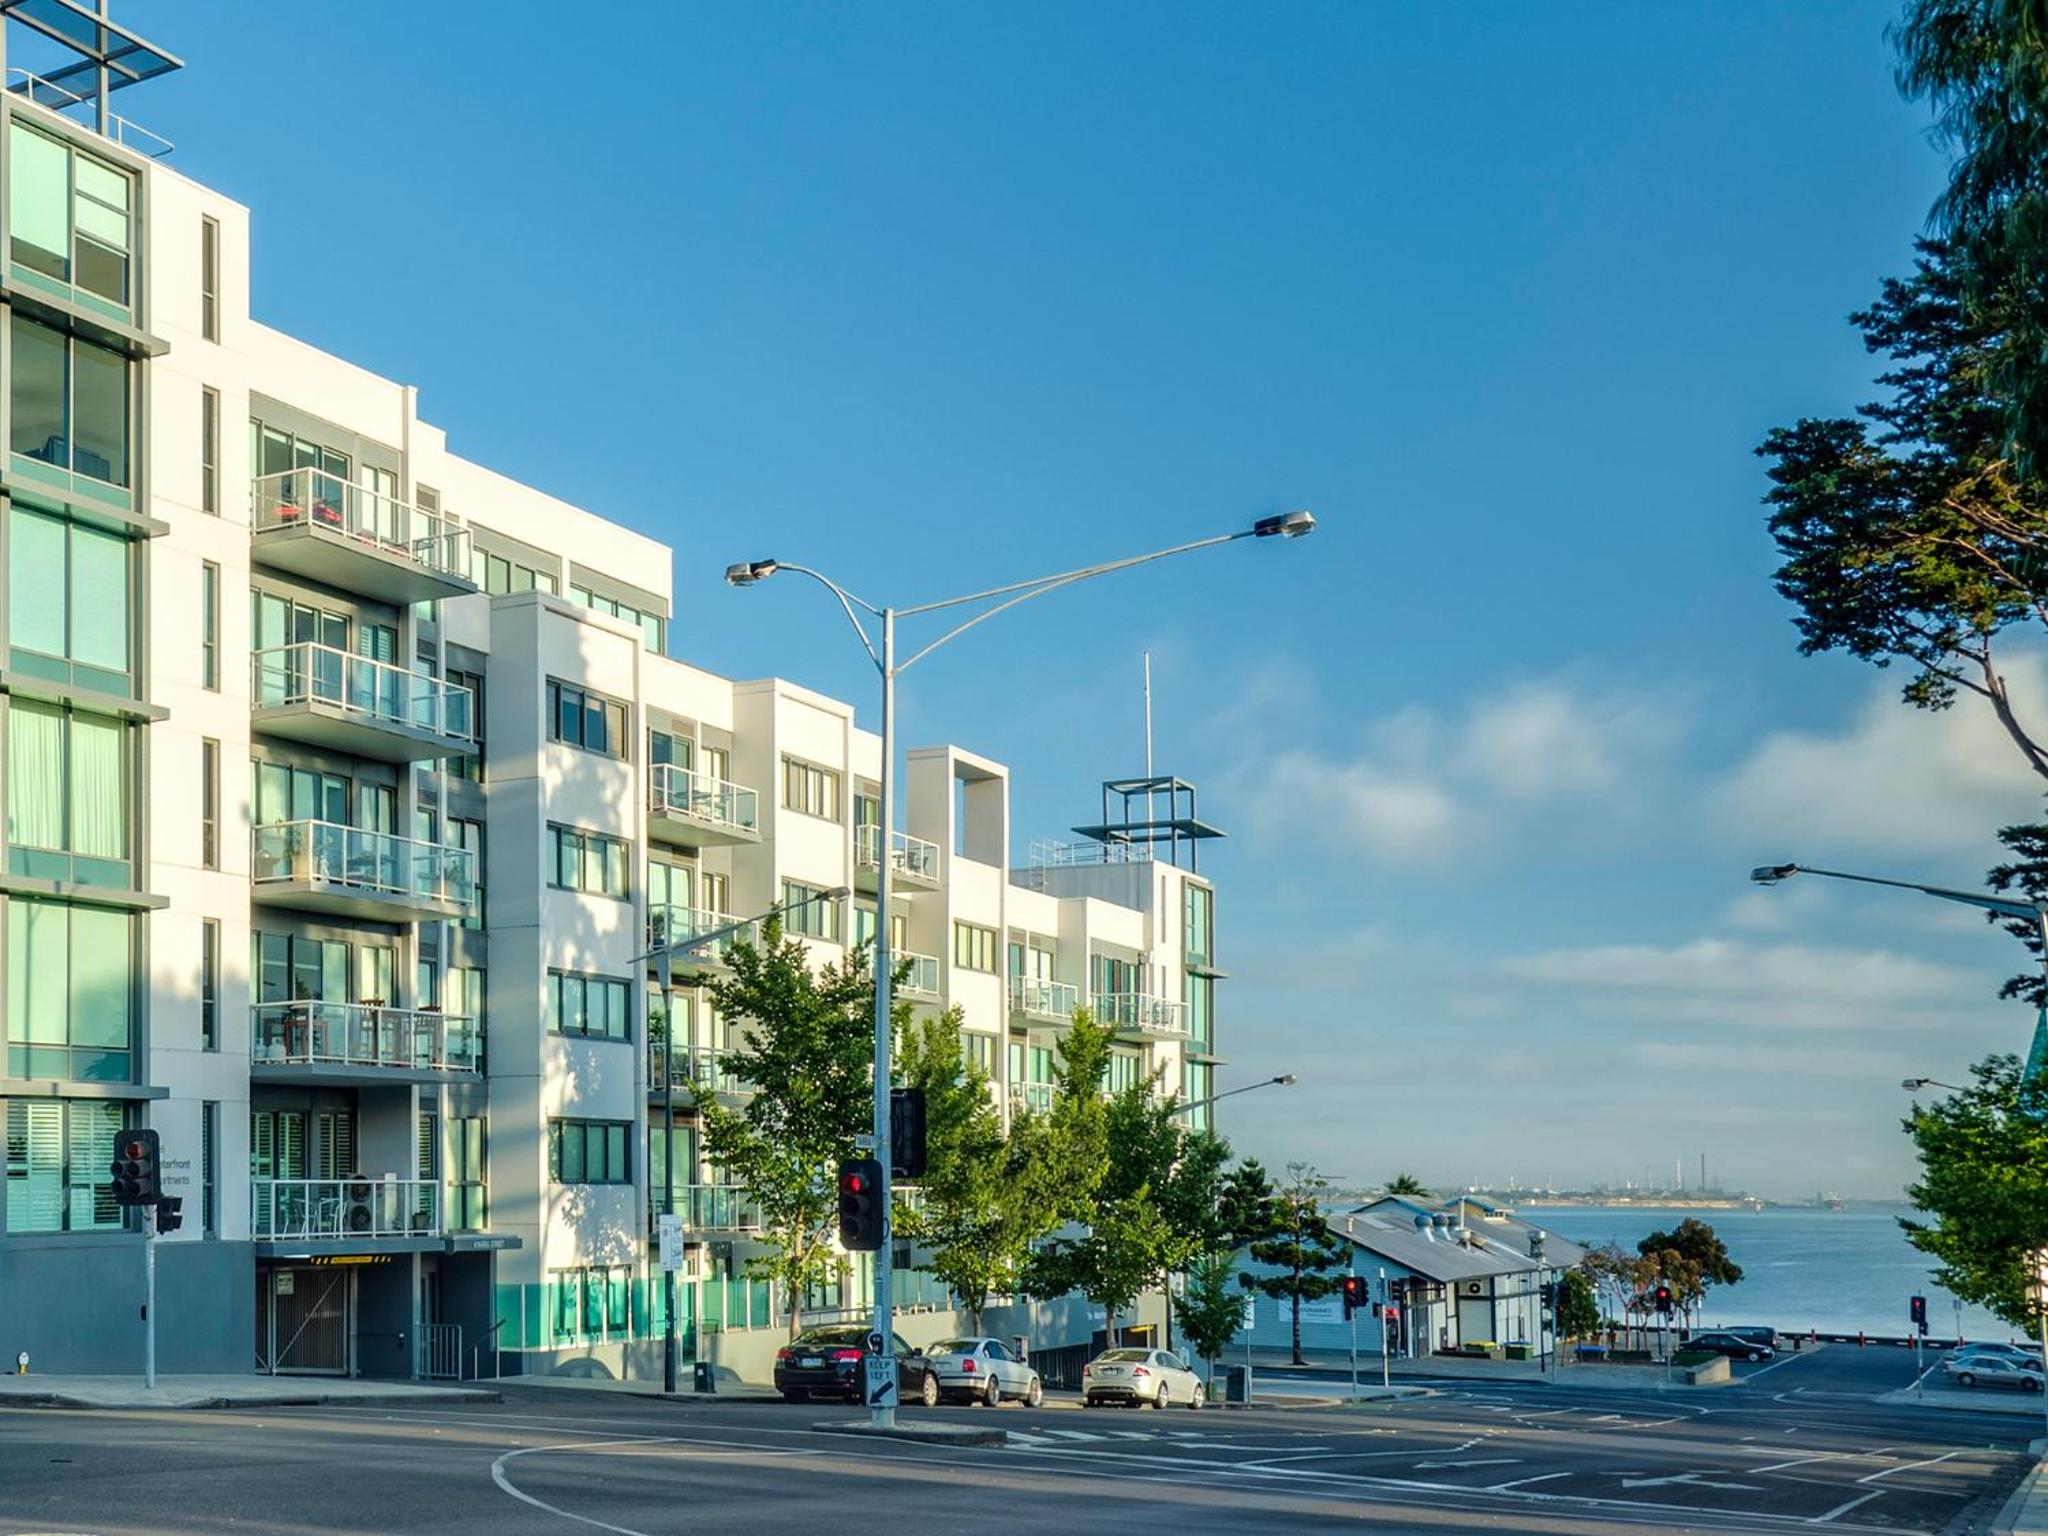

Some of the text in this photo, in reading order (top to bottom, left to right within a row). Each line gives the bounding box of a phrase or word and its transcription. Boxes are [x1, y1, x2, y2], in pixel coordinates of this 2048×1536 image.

[160, 1158, 191, 1169] terfront
[869, 1360, 891, 1370] KEEP
[870, 1370, 890, 1380] LEFT
